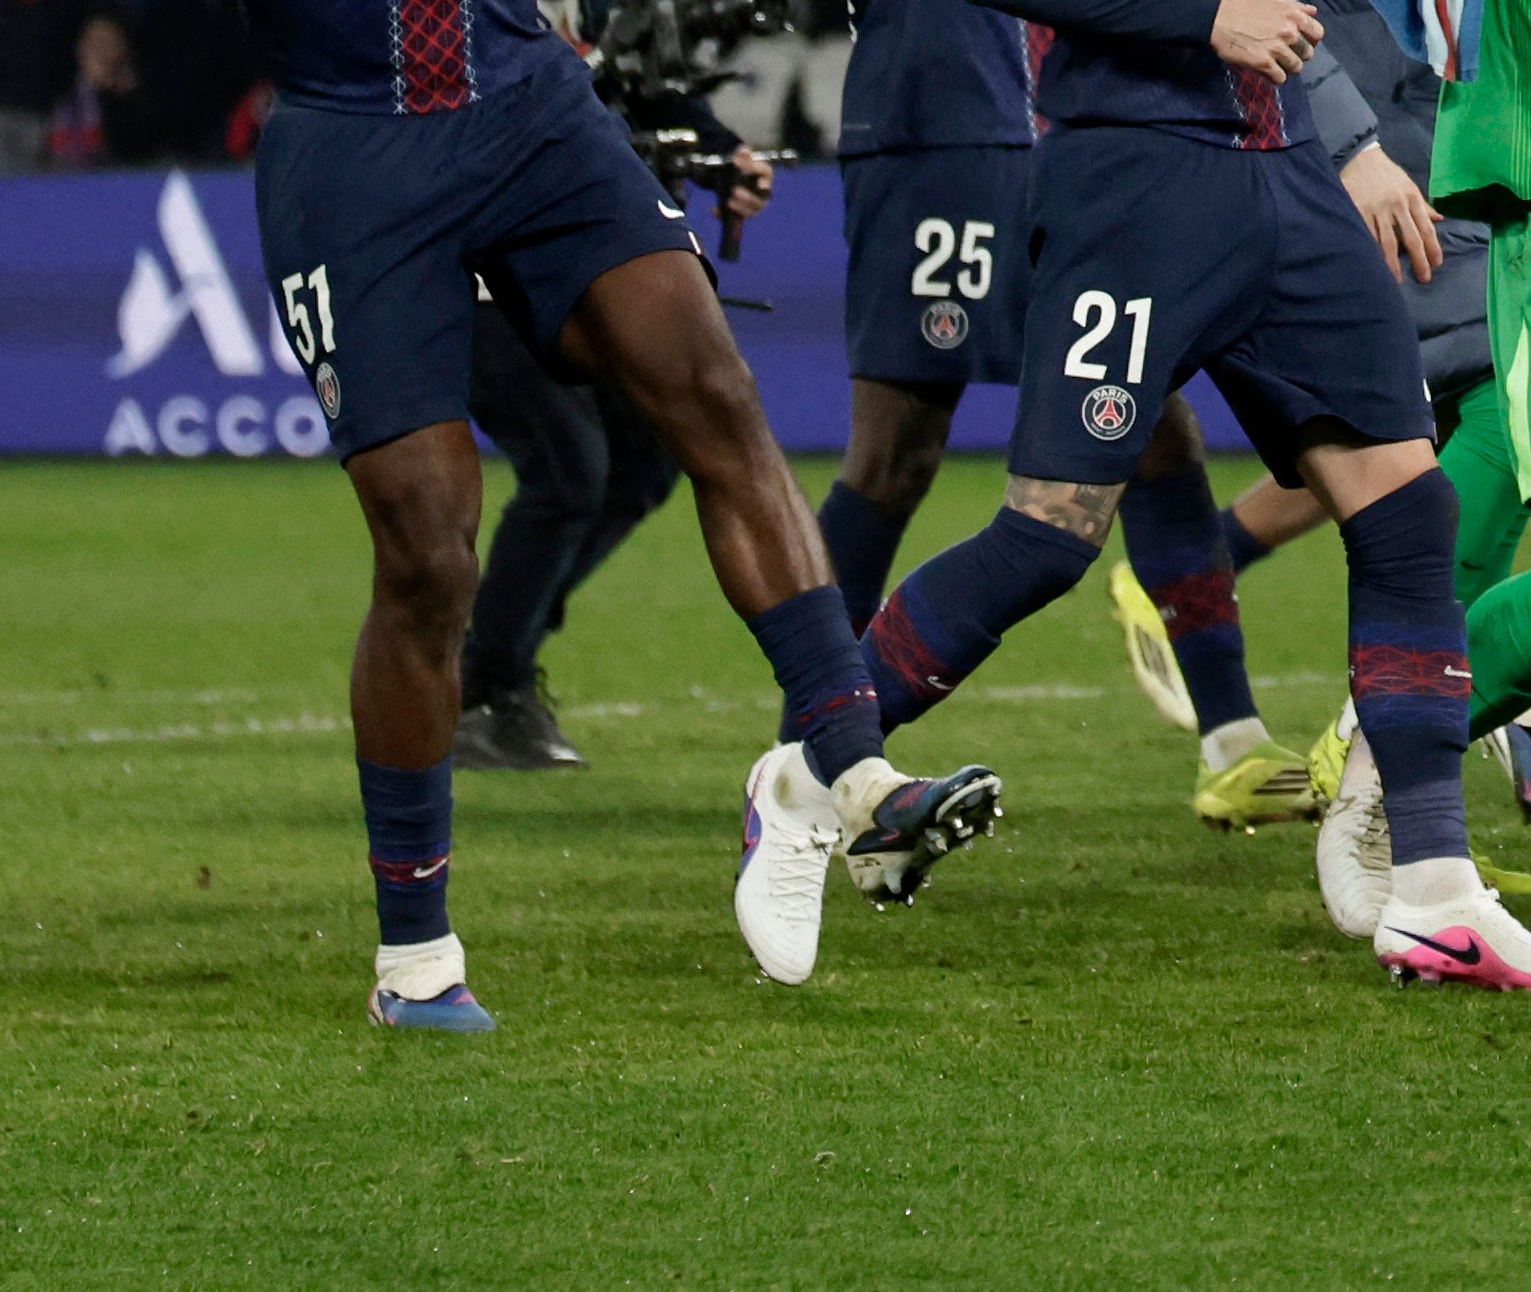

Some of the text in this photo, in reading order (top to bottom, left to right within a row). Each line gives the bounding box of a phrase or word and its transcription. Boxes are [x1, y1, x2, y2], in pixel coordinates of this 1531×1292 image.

[911, 217, 995, 300] 25
[281, 263, 336, 365] 51
[1064, 289, 1153, 384] 21
[104, 395, 332, 458] ACCO
[1092, 388, 1128, 404] PARIS
